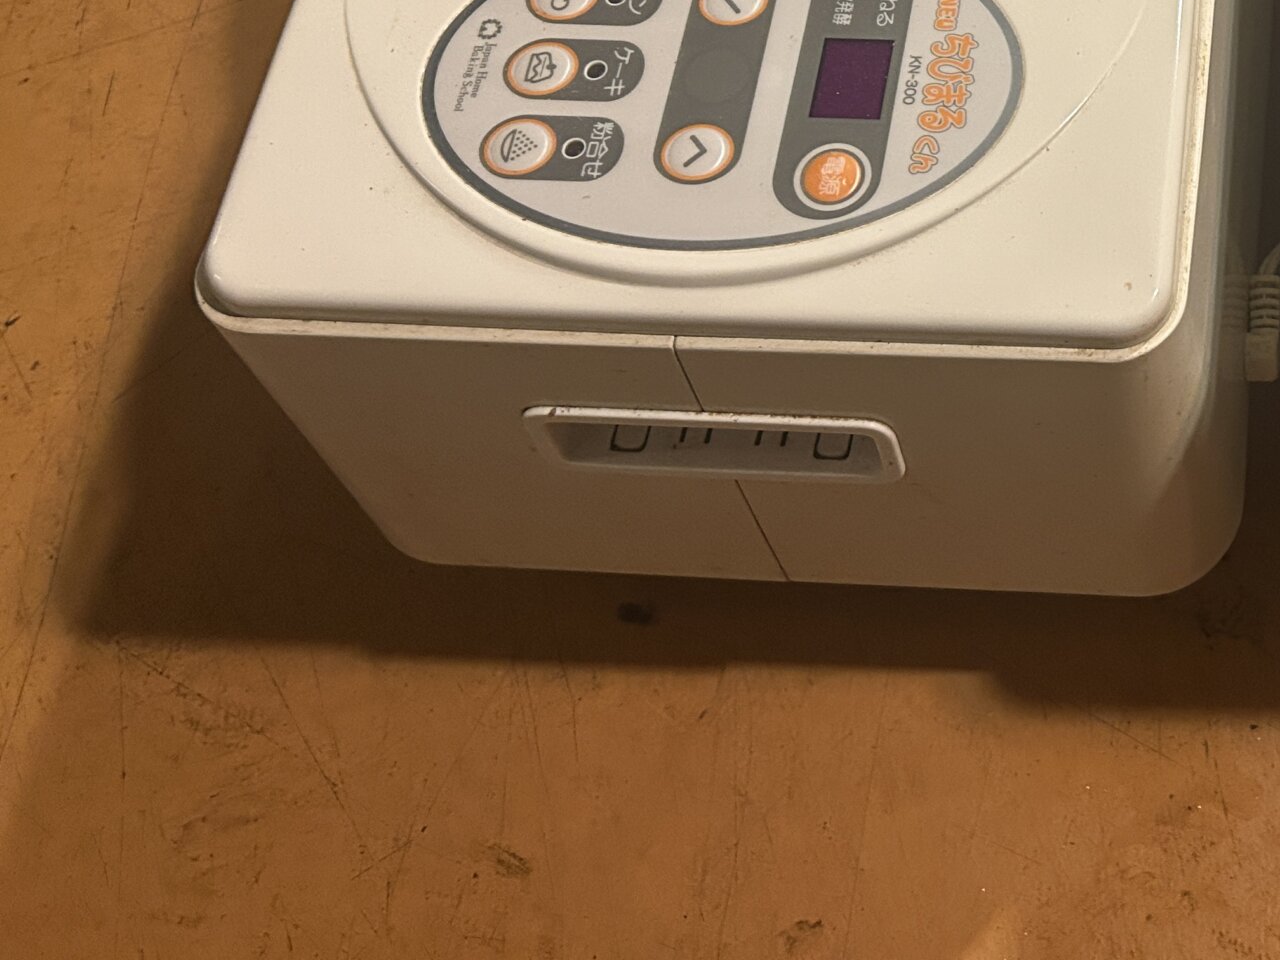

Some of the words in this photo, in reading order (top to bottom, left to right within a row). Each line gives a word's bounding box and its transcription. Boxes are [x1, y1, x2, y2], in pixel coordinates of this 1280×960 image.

[463, 45, 484, 79] Baking
[479, 42, 497, 69] Japan
[604, 47, 635, 96] ケーキ
[453, 81, 473, 112] School
[470, 71, 488, 98] Home
[903, 55, 923, 105] KN-300
[581, 121, 615, 179] 粉合せ
[819, 156, 847, 196] 電源
